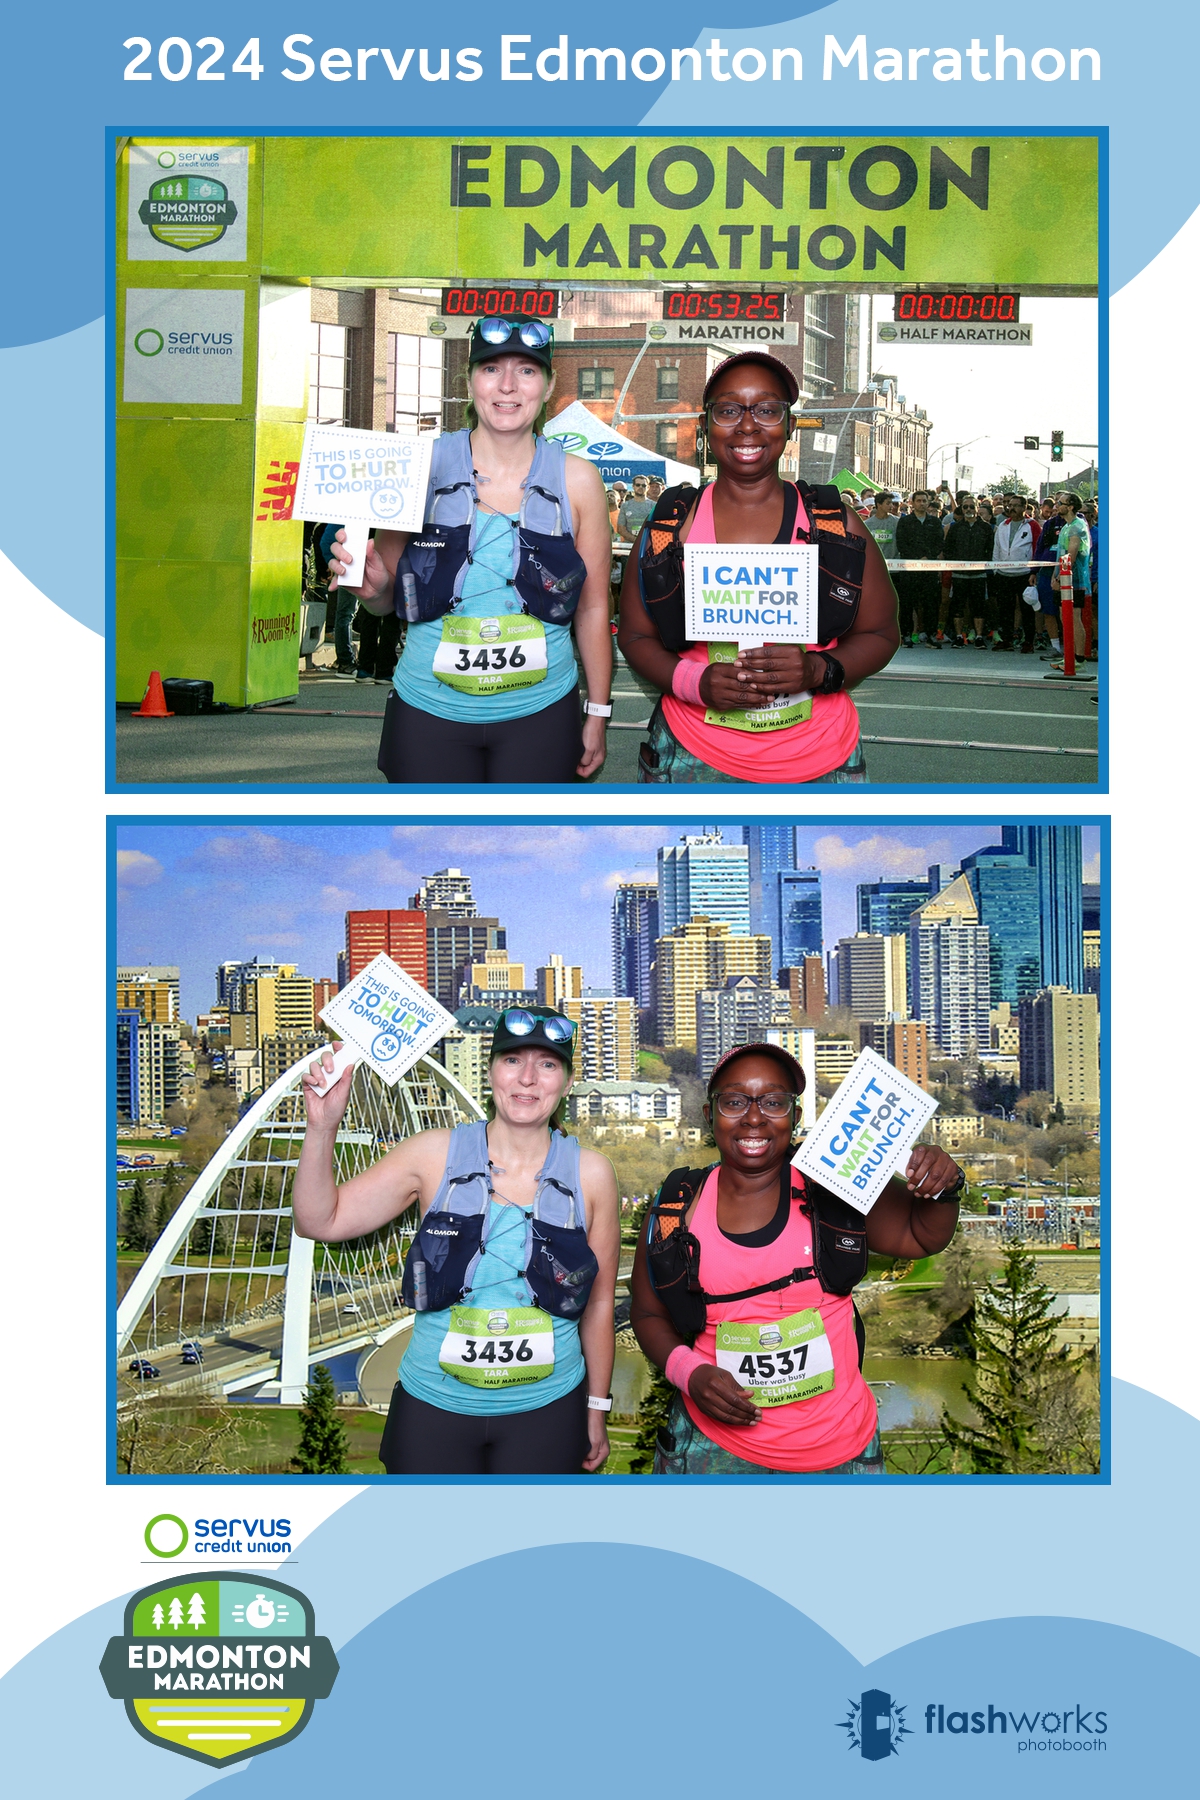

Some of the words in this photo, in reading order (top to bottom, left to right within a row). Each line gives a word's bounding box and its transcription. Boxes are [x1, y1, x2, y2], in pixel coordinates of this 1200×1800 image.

[178, 151, 220, 161] servus
[450, 144, 991, 212] EDMONTON
[150, 203, 227, 214] EDMONTON
[160, 214, 215, 222] MARATHON
[523, 222, 907, 272] MARATHON
[168, 332, 233, 345] servus
[678, 325, 785, 340] MARATHON
[900, 327, 939, 340] HALF
[942, 328, 1031, 341] MARATHON
[168, 344, 200, 355] credit
[203, 347, 232, 355] union
[313, 450, 346, 463] THIS
[350, 449, 362, 460] IS
[364, 446, 412, 459] GOING
[314, 463, 347, 481] TO
[351, 459, 411, 479] HURT
[599, 466, 631, 477] nion
[314, 477, 414, 495] TOMORROW.
[702, 566, 709, 584] I
[714, 566, 799, 586] CAN'T
[701, 589, 755, 605] WAIT
[758, 590, 799, 606] FOR
[702, 608, 798, 625] BRUNCH.
[454, 645, 527, 672] 3436
[477, 675, 503, 684] TARA
[478, 684, 495, 692] HALF
[496, 681, 532, 691] MARATHON
[773, 700, 790, 709] busy
[745, 711, 781, 721] CELINA
[768, 714, 803, 727] MARATHON
[365, 975, 389, 996] THIS
[388, 989, 400, 1002] IS
[399, 997, 436, 1023] GOING
[358, 986, 381, 1008] TO
[378, 1000, 428, 1035] HURT
[347, 999, 416, 1048] TOMORROW.
[819, 1155, 836, 1169] I
[829, 1077, 884, 1156] CAN'T
[837, 1128, 875, 1179] WAIT
[869, 1091, 902, 1132] FOR
[852, 1107, 915, 1190] BRUNCH.
[461, 1338, 533, 1363] 3436
[738, 1344, 809, 1378] 4537
[483, 1369, 509, 1377] TARA
[501, 1375, 539, 1384] MARATHON
[748, 1378, 768, 1386] Uber
[788, 1372, 807, 1382] busy
[760, 1384, 798, 1397] CELINA
[768, 1396, 785, 1404] HALF
[786, 1384, 824, 1400] MARATHON
